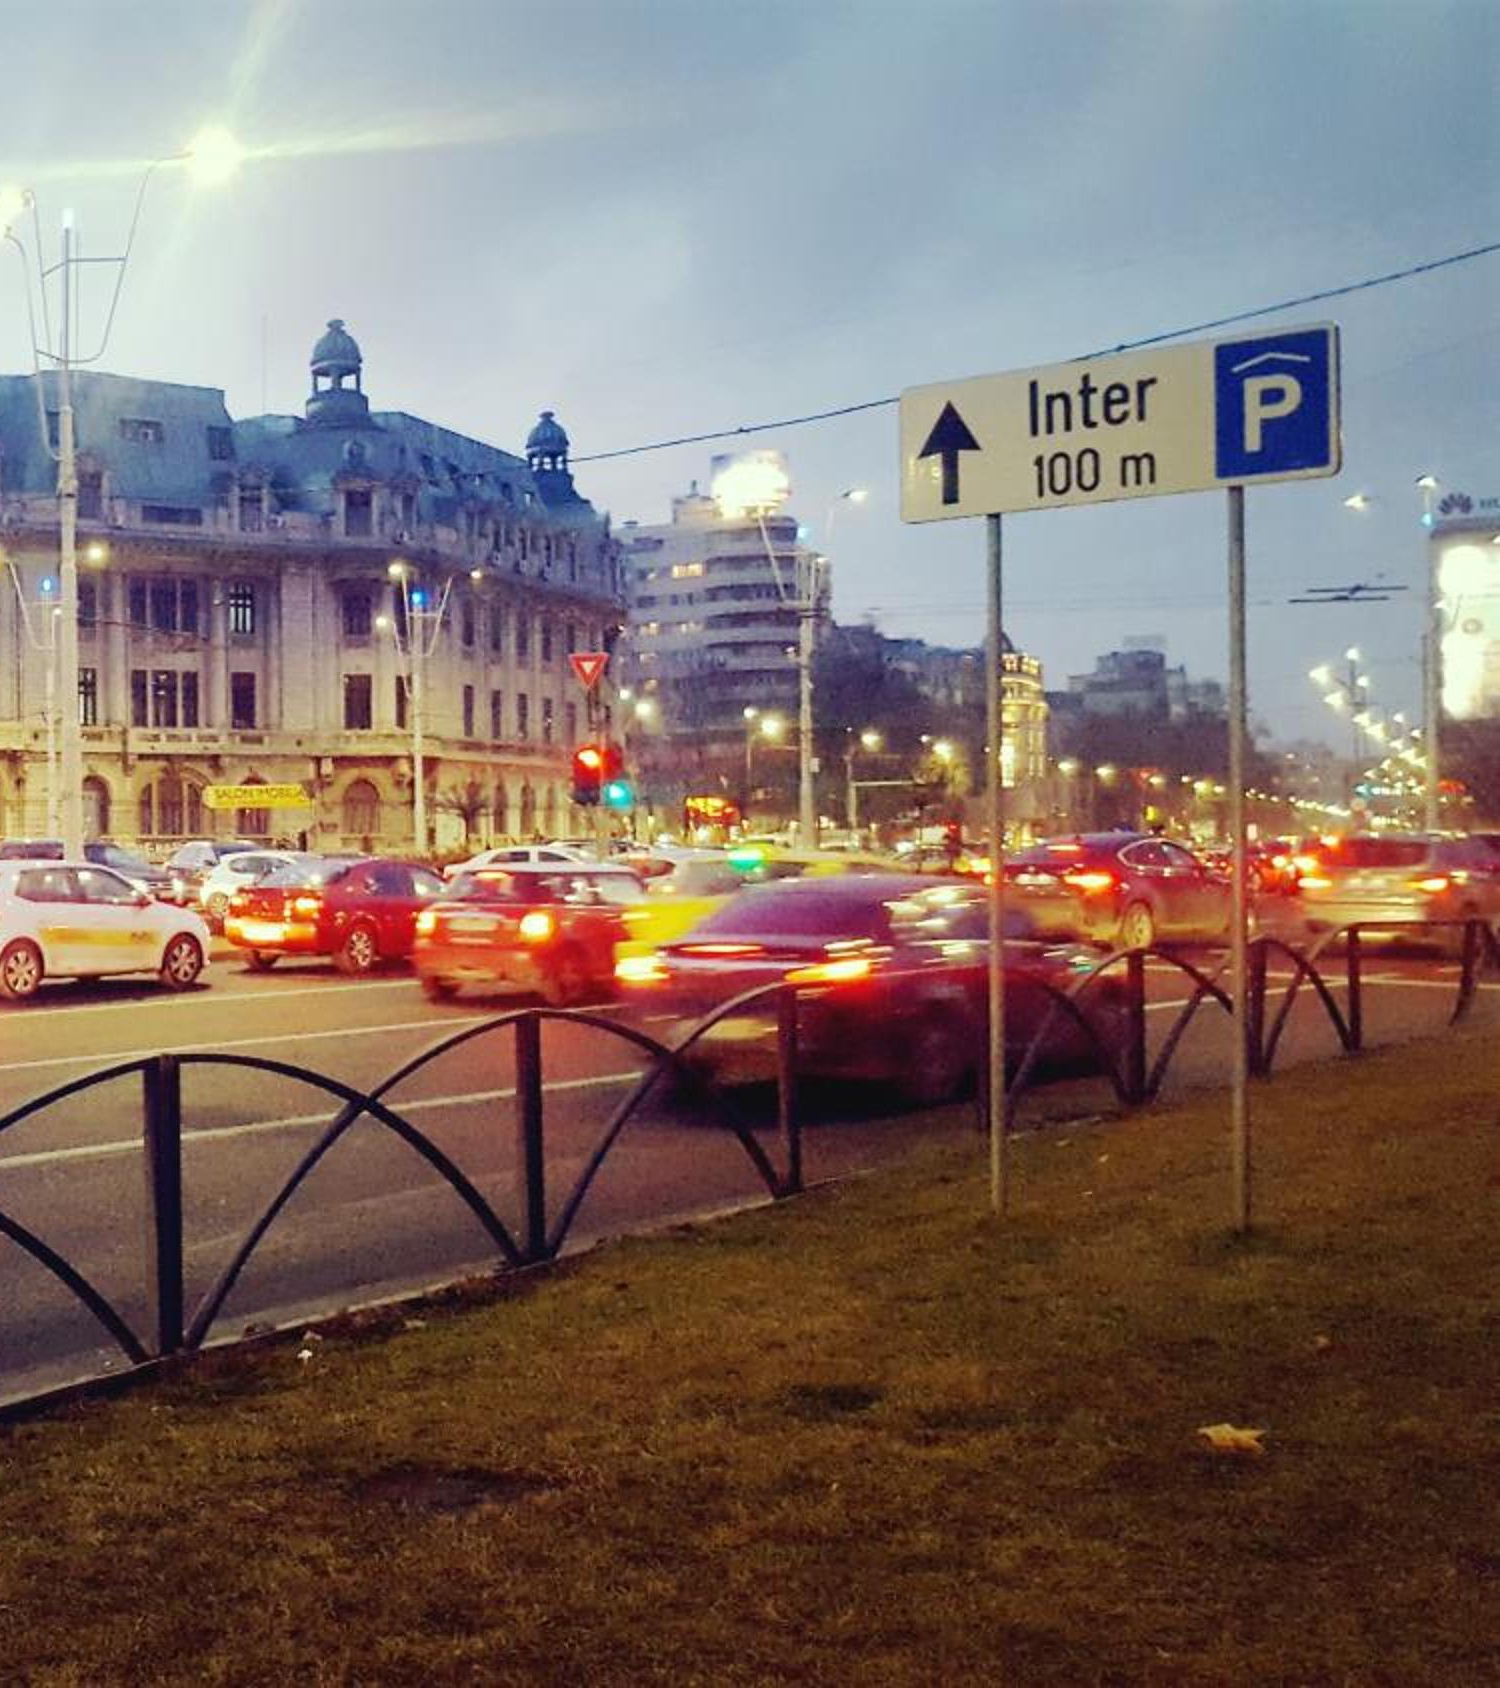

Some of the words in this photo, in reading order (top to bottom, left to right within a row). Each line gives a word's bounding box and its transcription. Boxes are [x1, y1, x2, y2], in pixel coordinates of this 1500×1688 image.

[1029, 374, 1158, 438] Inter
[1242, 373, 1302, 454] P
[1032, 447, 1101, 499] 100
[1120, 450, 1157, 487] m
